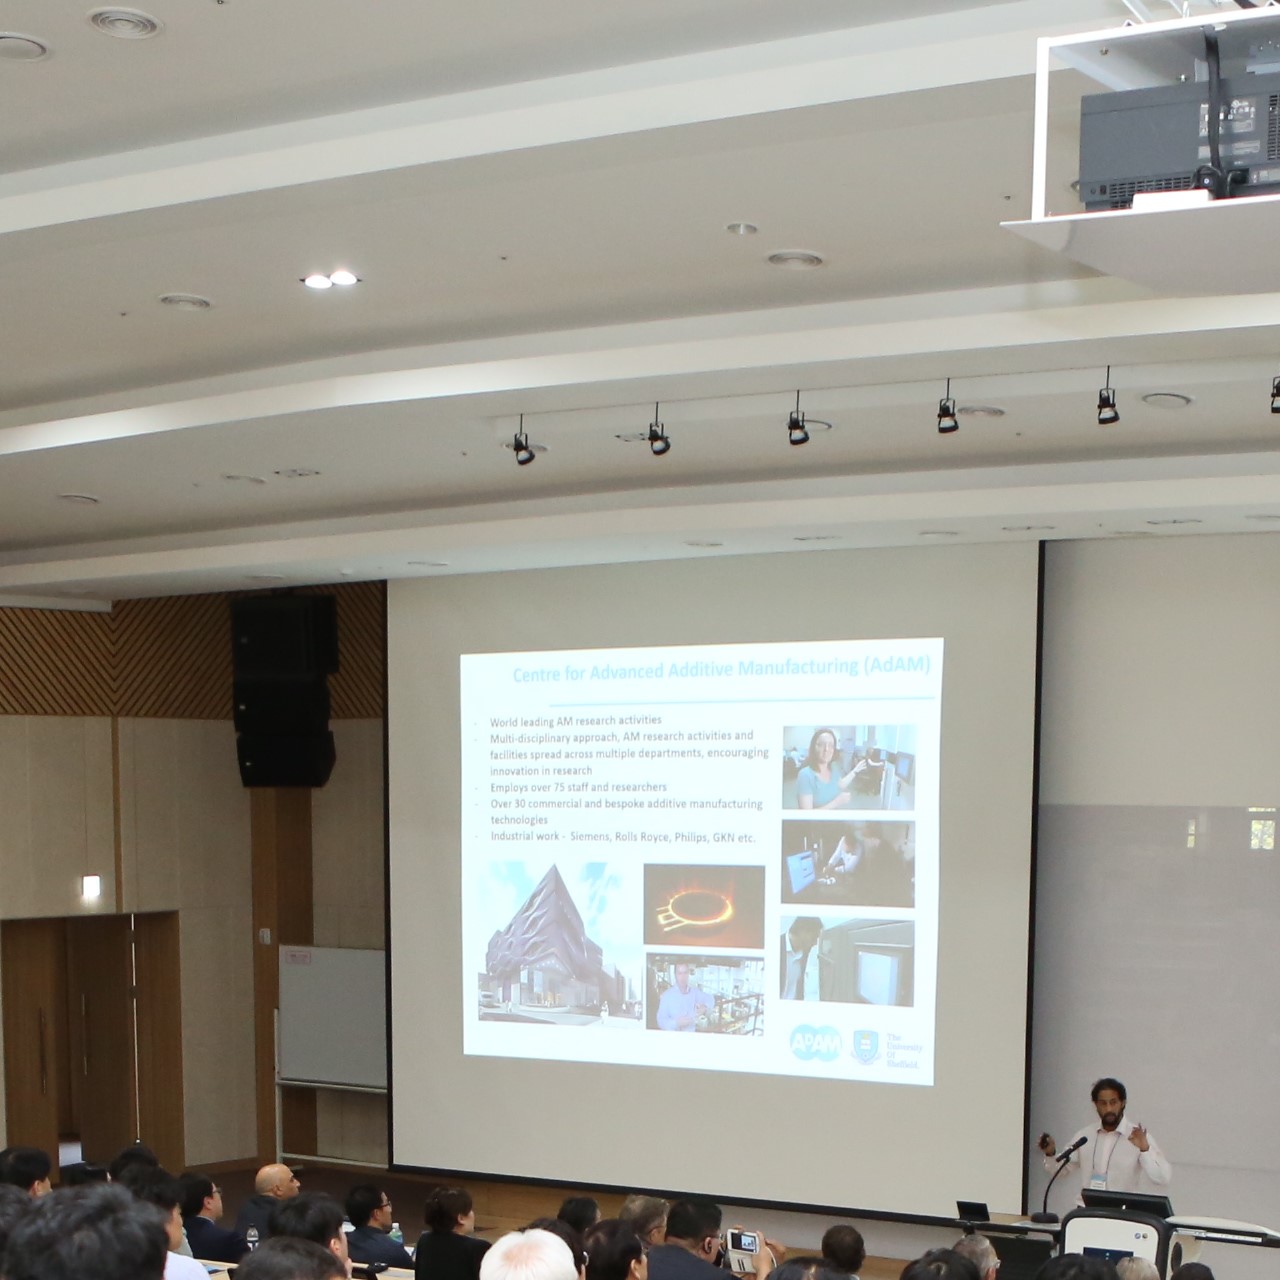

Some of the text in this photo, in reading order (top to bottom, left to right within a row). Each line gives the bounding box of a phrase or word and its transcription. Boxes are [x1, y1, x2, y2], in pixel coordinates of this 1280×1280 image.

[512, 655, 931, 682] Centre for Advanced Additive Manufacturing (AdAM)
[490, 714, 661, 729] World leading AM research activities
[489, 730, 753, 744] Multi-disciplinary approach, AM research activities and
[489, 747, 769, 761] facilities spread across multiple departments, encouraging
[489, 765, 592, 776] innovation in research
[490, 781, 667, 794] Employs over 75 staff and researchers
[490, 798, 763, 811] Over 30 commercial and bespoke additive manufacturing
[490, 814, 548, 827] technologies
[490, 831, 533, 840] Industrial
[535, 831, 559, 840] work
[570, 832, 612, 843] Siemens,
[614, 832, 637, 841] Rolls
[640, 832, 671, 843] Royce,
[674, 832, 709, 844] Philips,
[712, 832, 734, 842] GKN
[737, 833, 755, 843] etc.
